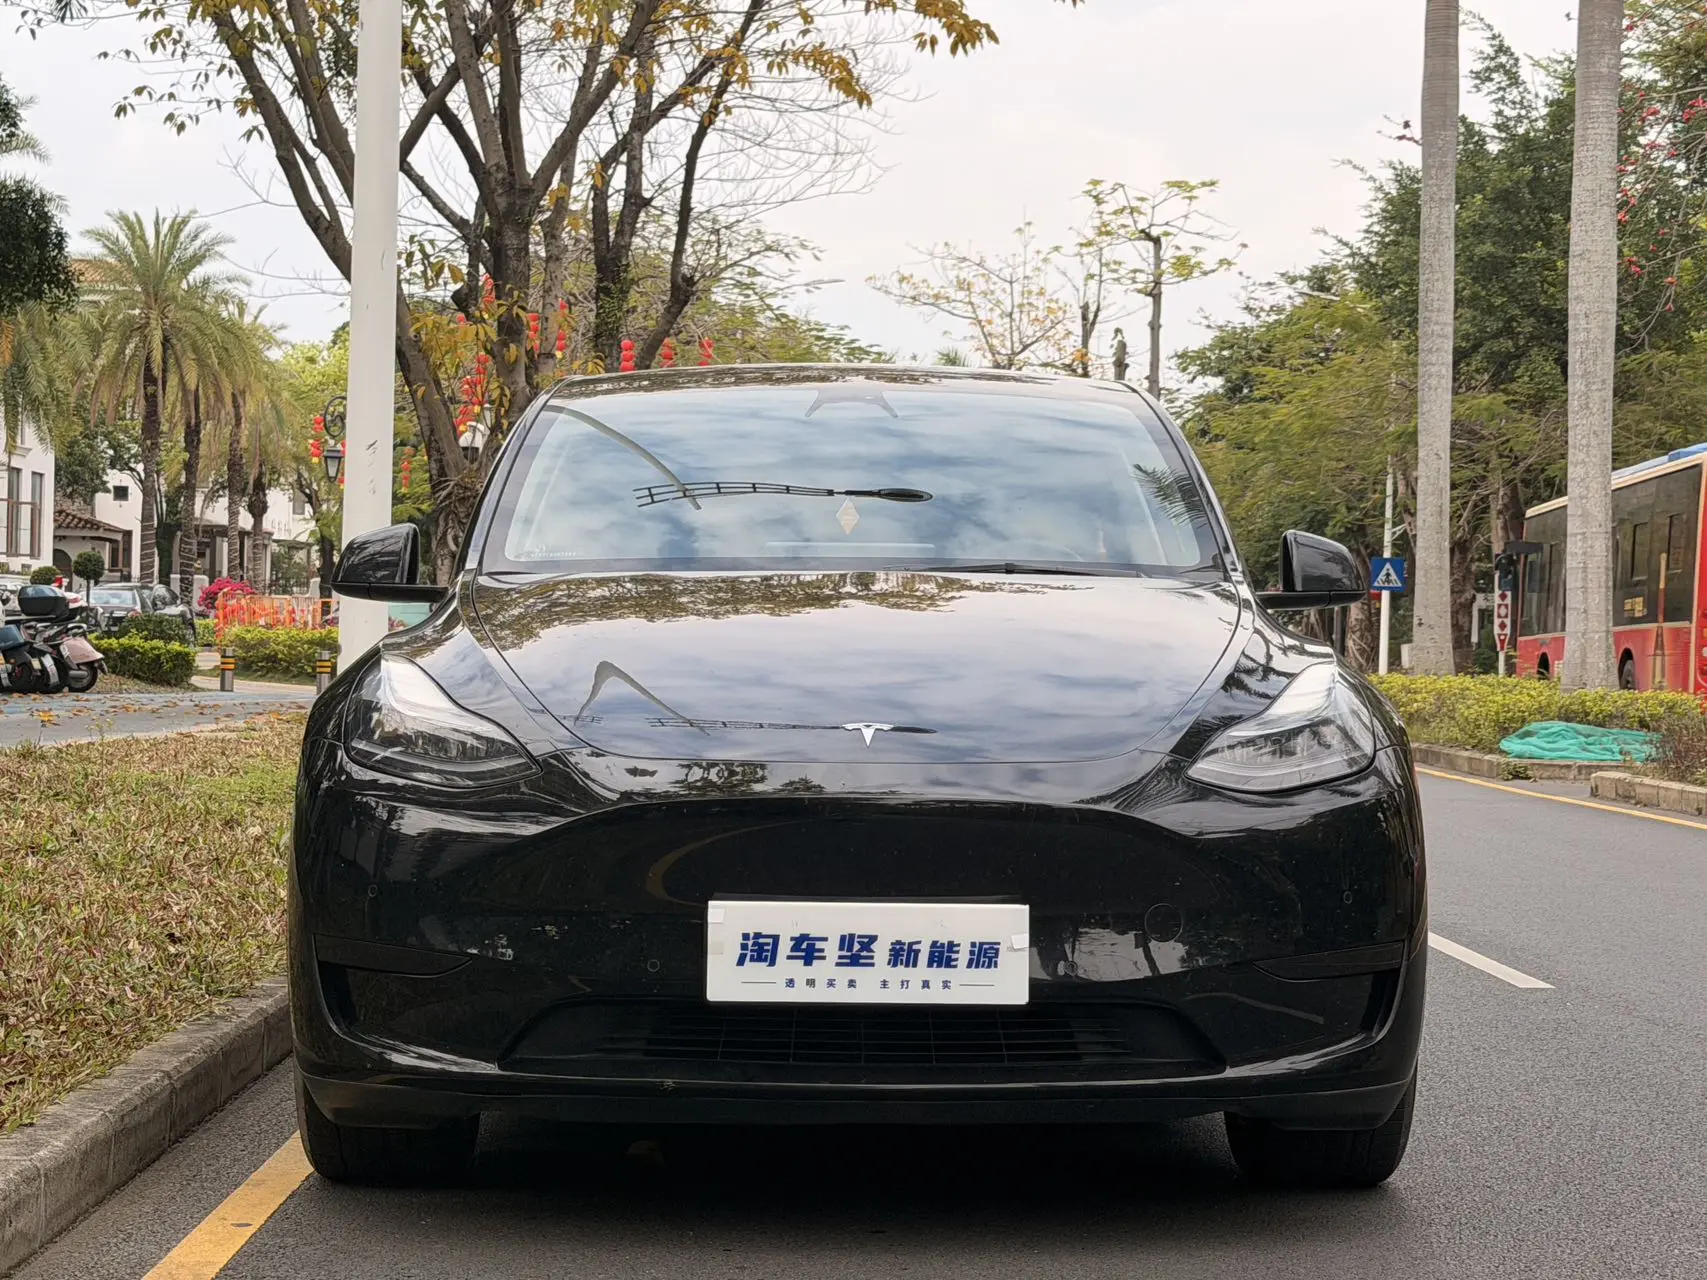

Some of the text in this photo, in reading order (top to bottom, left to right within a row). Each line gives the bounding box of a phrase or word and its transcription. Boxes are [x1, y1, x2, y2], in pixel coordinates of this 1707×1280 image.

[735, 931, 1002, 970] 淘车坚新能源
[785, 977, 952, 990] 透明买卖 主打真实
